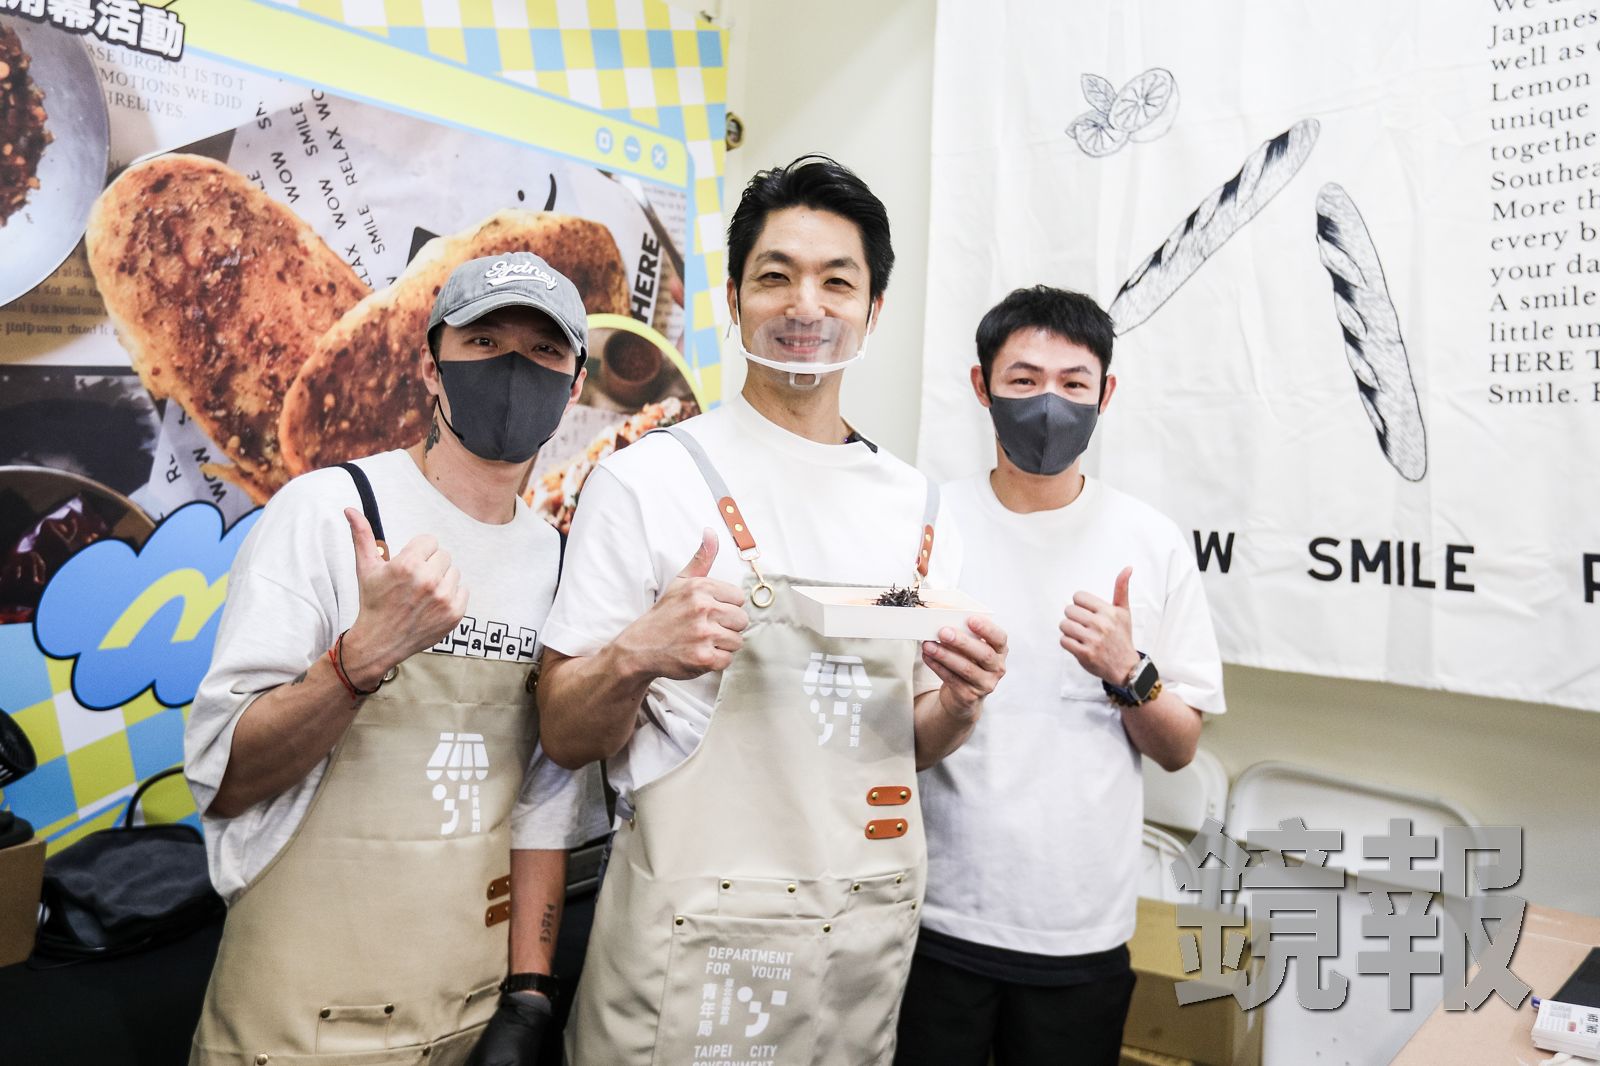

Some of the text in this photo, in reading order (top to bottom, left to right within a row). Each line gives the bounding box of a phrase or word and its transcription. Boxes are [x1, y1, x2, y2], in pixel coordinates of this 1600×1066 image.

[1487, 9, 1597, 49] Japanes
[121, 53, 190, 79] URGENT
[195, 69, 209, 83] IS
[212, 72, 233, 88] TO
[1491, 45, 1547, 71] well
[1558, 44, 1585, 61] as
[185, 86, 210, 102] WE
[214, 92, 242, 110] DID
[1490, 72, 1591, 101] Lemon
[290, 102, 319, 157] SMILE
[1490, 102, 1589, 131] unique
[326, 126, 358, 186] RELAX
[1491, 131, 1597, 163] togethe
[271, 151, 300, 203] WOW
[319, 178, 347, 230] WOW
[1493, 199, 1566, 221] More
[357, 204, 386, 255] SMILE
[1491, 221, 1596, 251] every b
[485, 261, 558, 290] Sydney
[630, 232, 661, 324] HERE
[1490, 253, 1600, 287] your da
[1490, 285, 1597, 312] A smile
[1489, 320, 1554, 343] little
[1489, 350, 1574, 373] HERE
[1488, 382, 1579, 404] Smile.
[1307, 537, 1475, 592] SMILE
[708, 946, 794, 965] DEPARTMENT
[705, 961, 792, 980] FOR YOUTH
[694, 1044, 778, 1058] TAIPEI CITY
